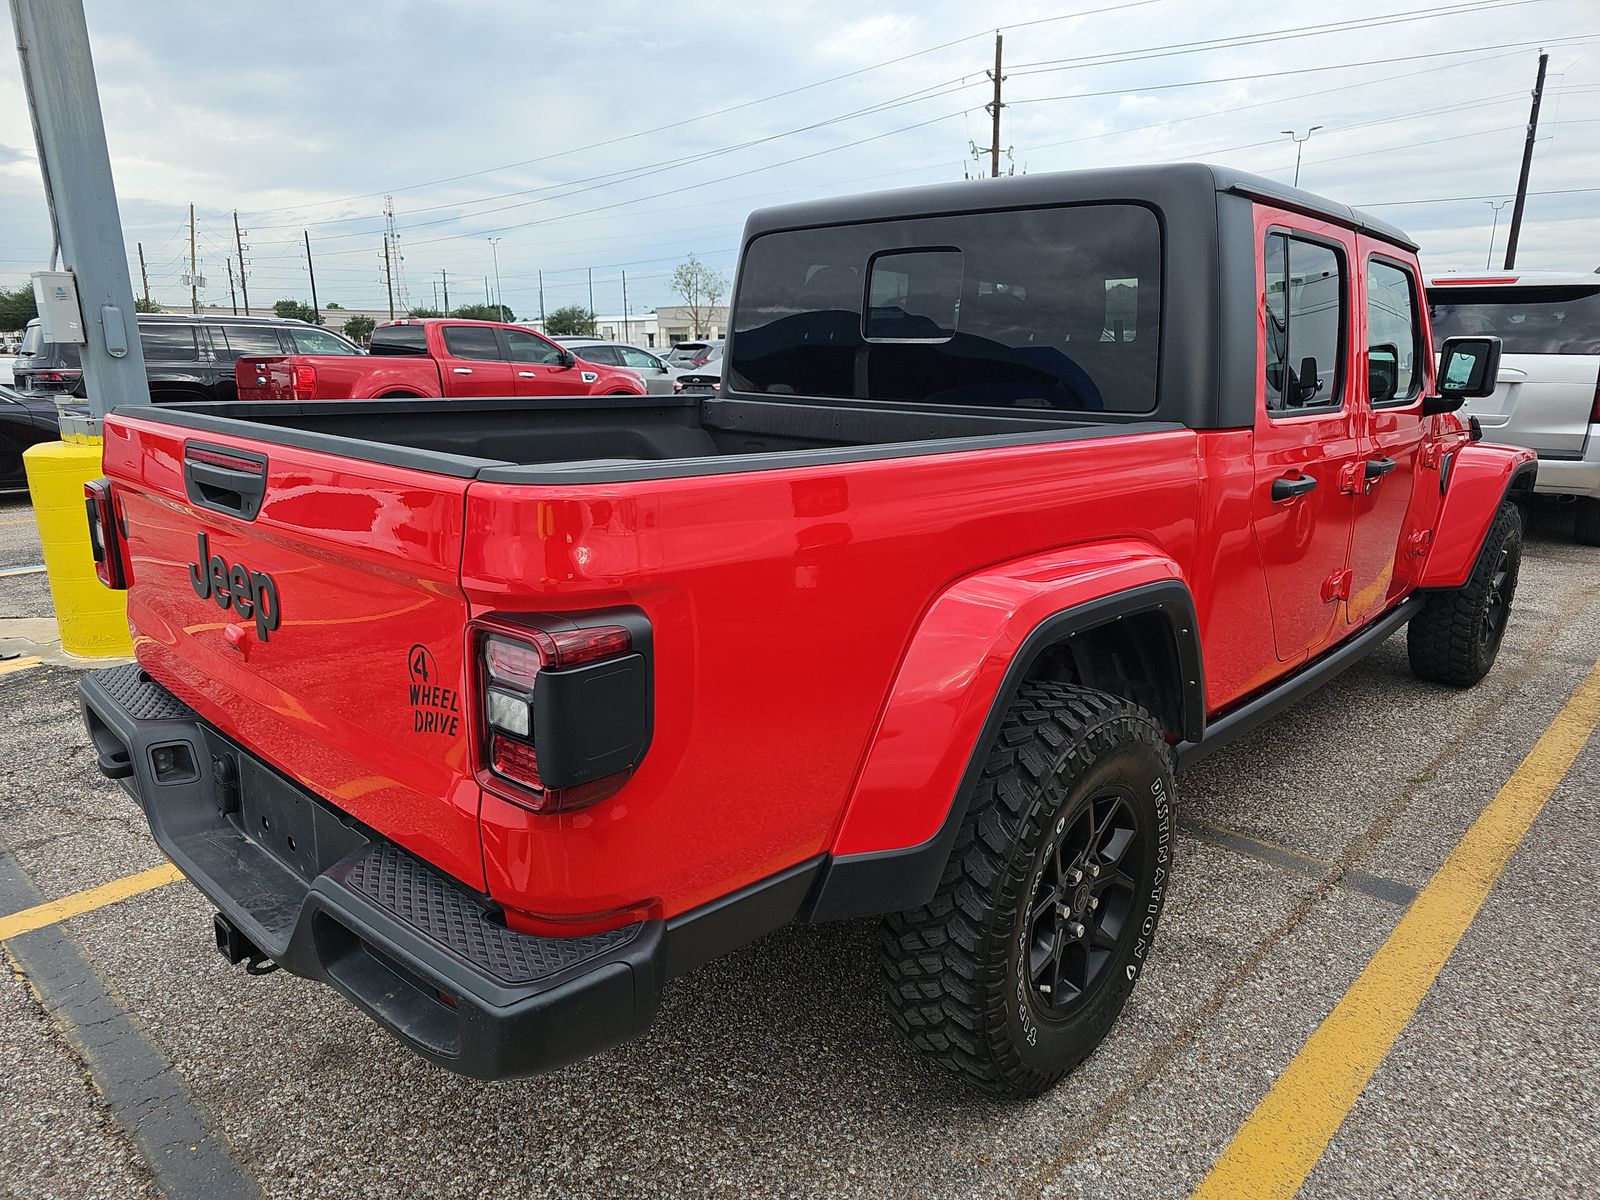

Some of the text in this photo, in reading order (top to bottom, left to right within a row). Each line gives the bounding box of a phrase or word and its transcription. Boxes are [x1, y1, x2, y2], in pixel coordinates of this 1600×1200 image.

[188, 530, 280, 643] Jeep
[413, 651, 428, 682] 4
[409, 684, 458, 712] WHEEL
[414, 709, 459, 737] DRIVE
[1134, 777, 1170, 959] DESTINATION
